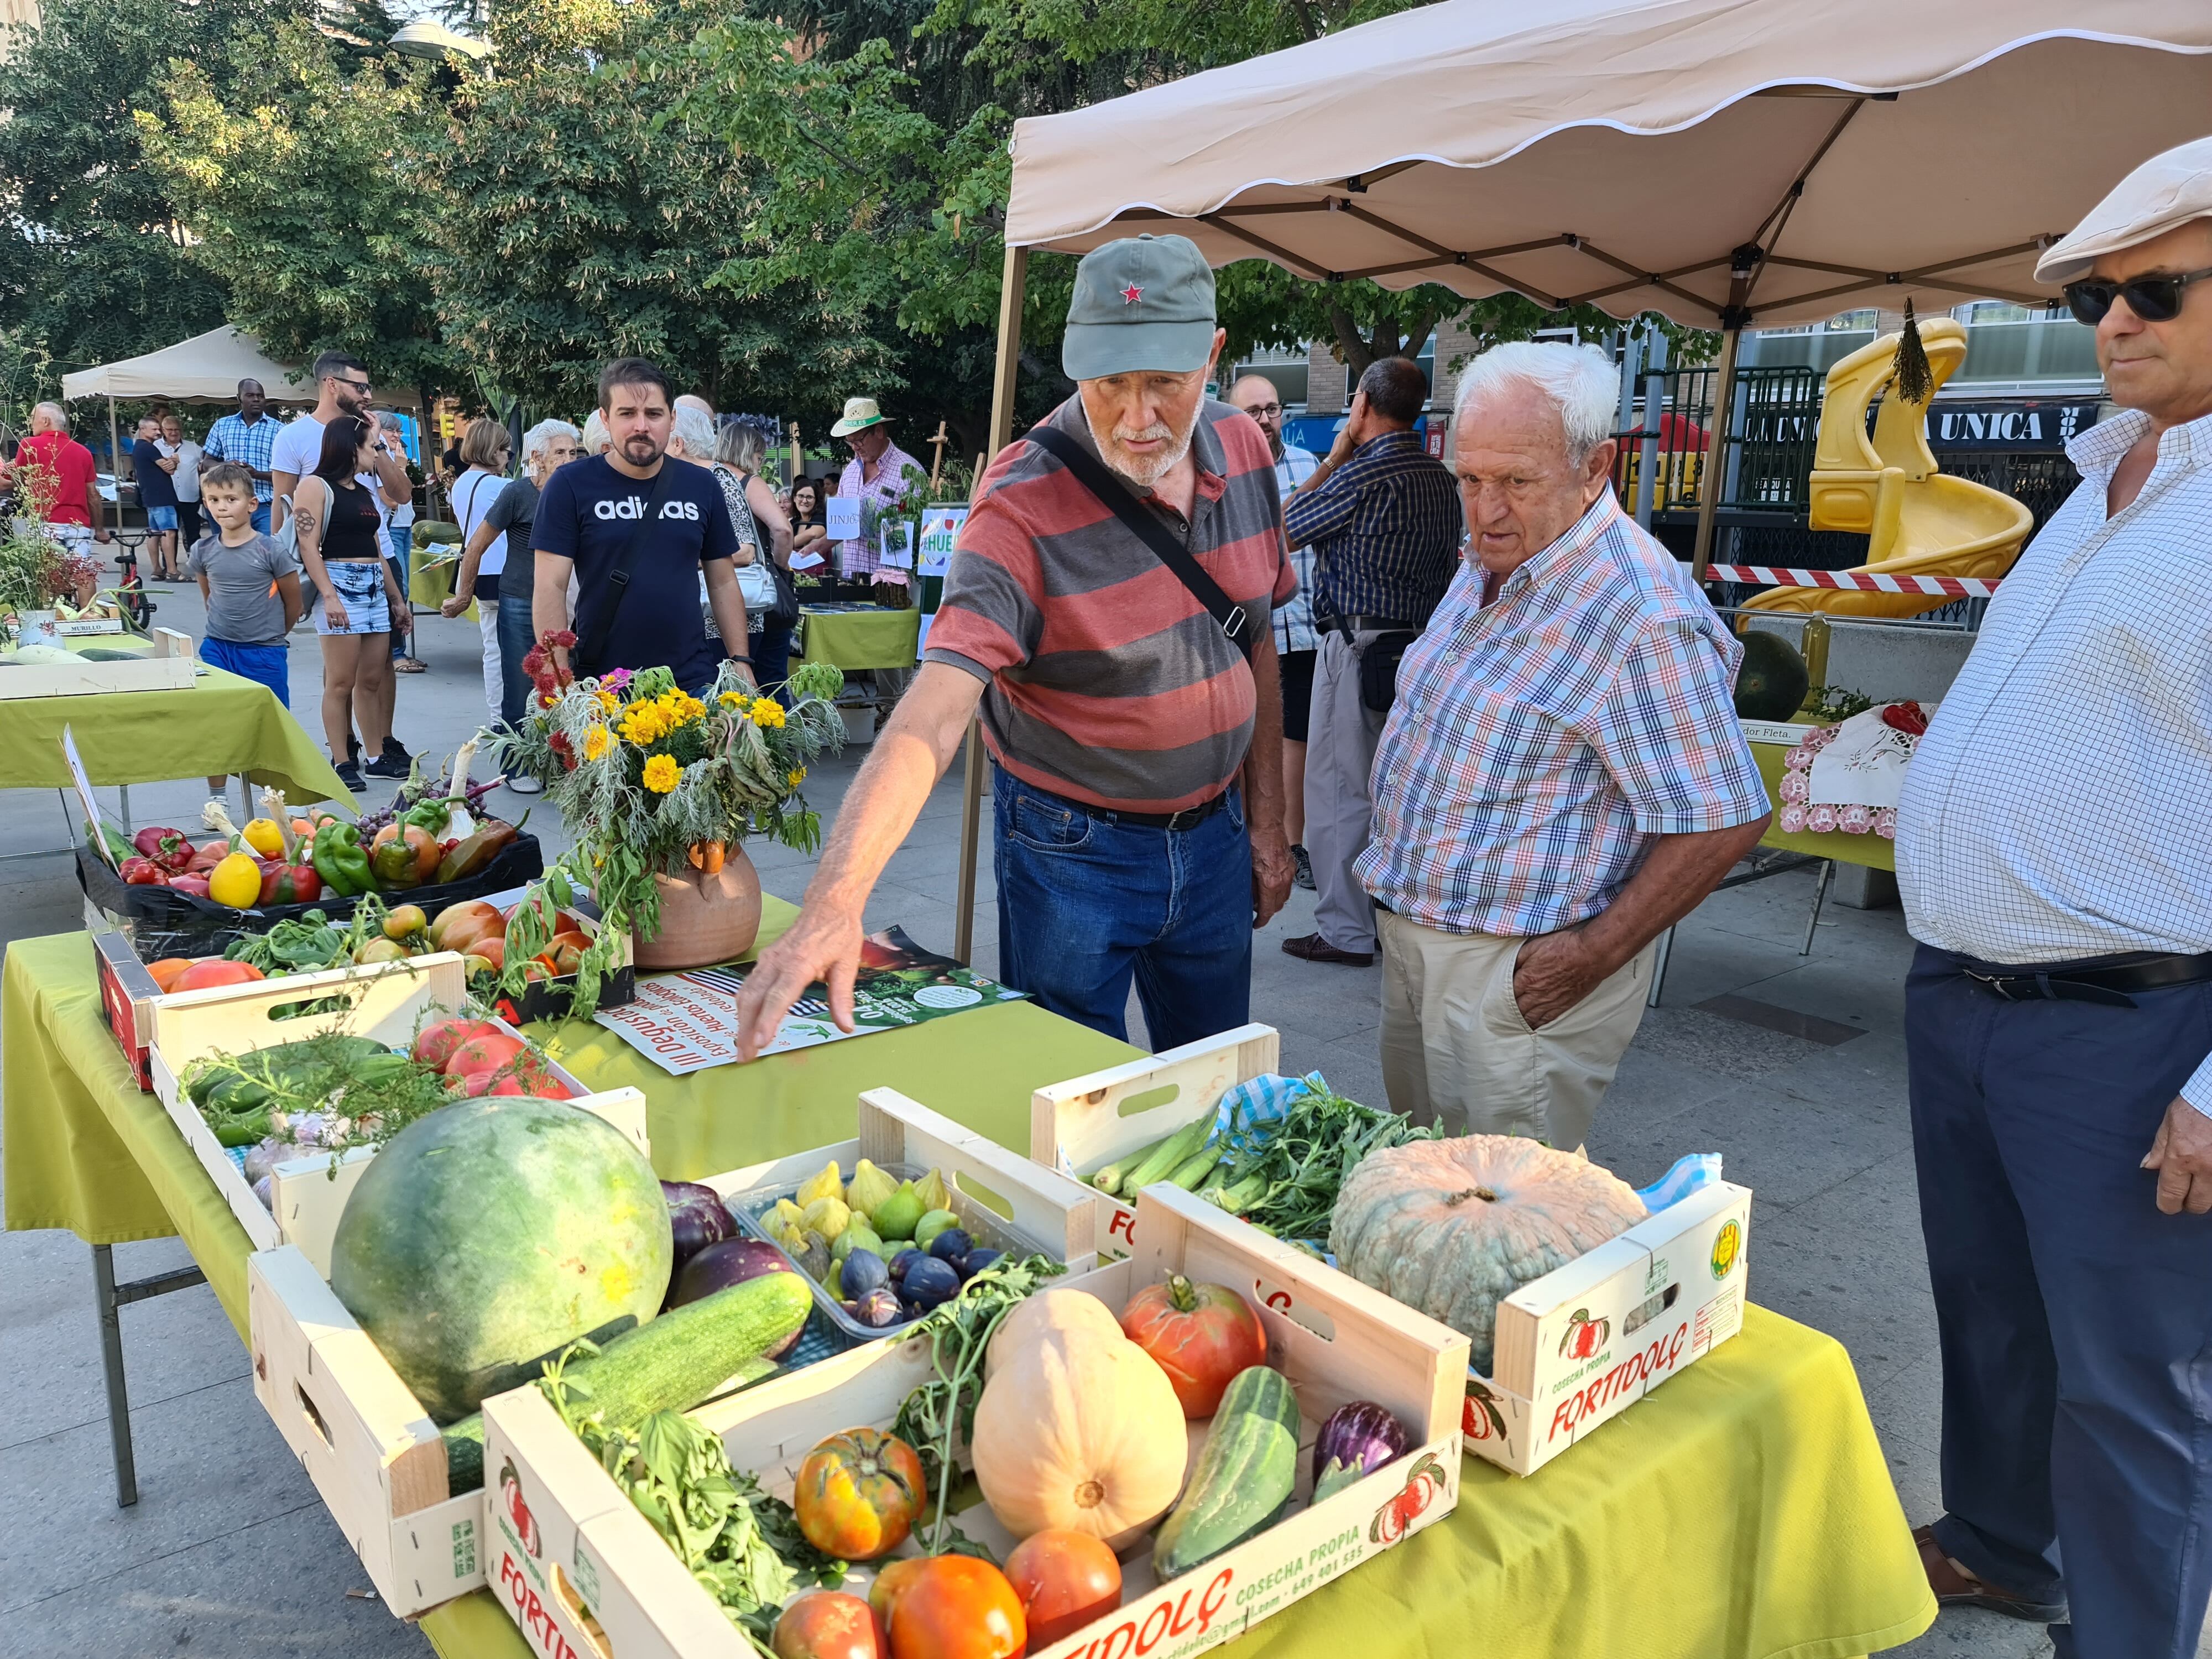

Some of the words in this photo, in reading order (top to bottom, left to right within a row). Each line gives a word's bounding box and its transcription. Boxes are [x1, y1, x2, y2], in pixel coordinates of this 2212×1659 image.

[1940, 413, 2043, 441] UNICA
[594, 496, 699, 521] adias
[928, 535, 959, 552] HUE
[1764, 728, 1791, 738] Fleta.
[683, 1004, 729, 1032] Huertos
[666, 1017, 731, 1057] Exposición
[1548, 1322, 1688, 1444] FORTIDOLÇ
[1552, 1366, 1584, 1395] COSECHA
[1585, 1350, 1611, 1374] PROPIA
[1235, 1557, 1304, 1606] COSECHA
[1309, 1525, 1359, 1567] PROPIA
[1291, 1573, 1313, 1595] 649
[1318, 1561, 1339, 1580] 401
[1342, 1545, 1364, 1567] 535
